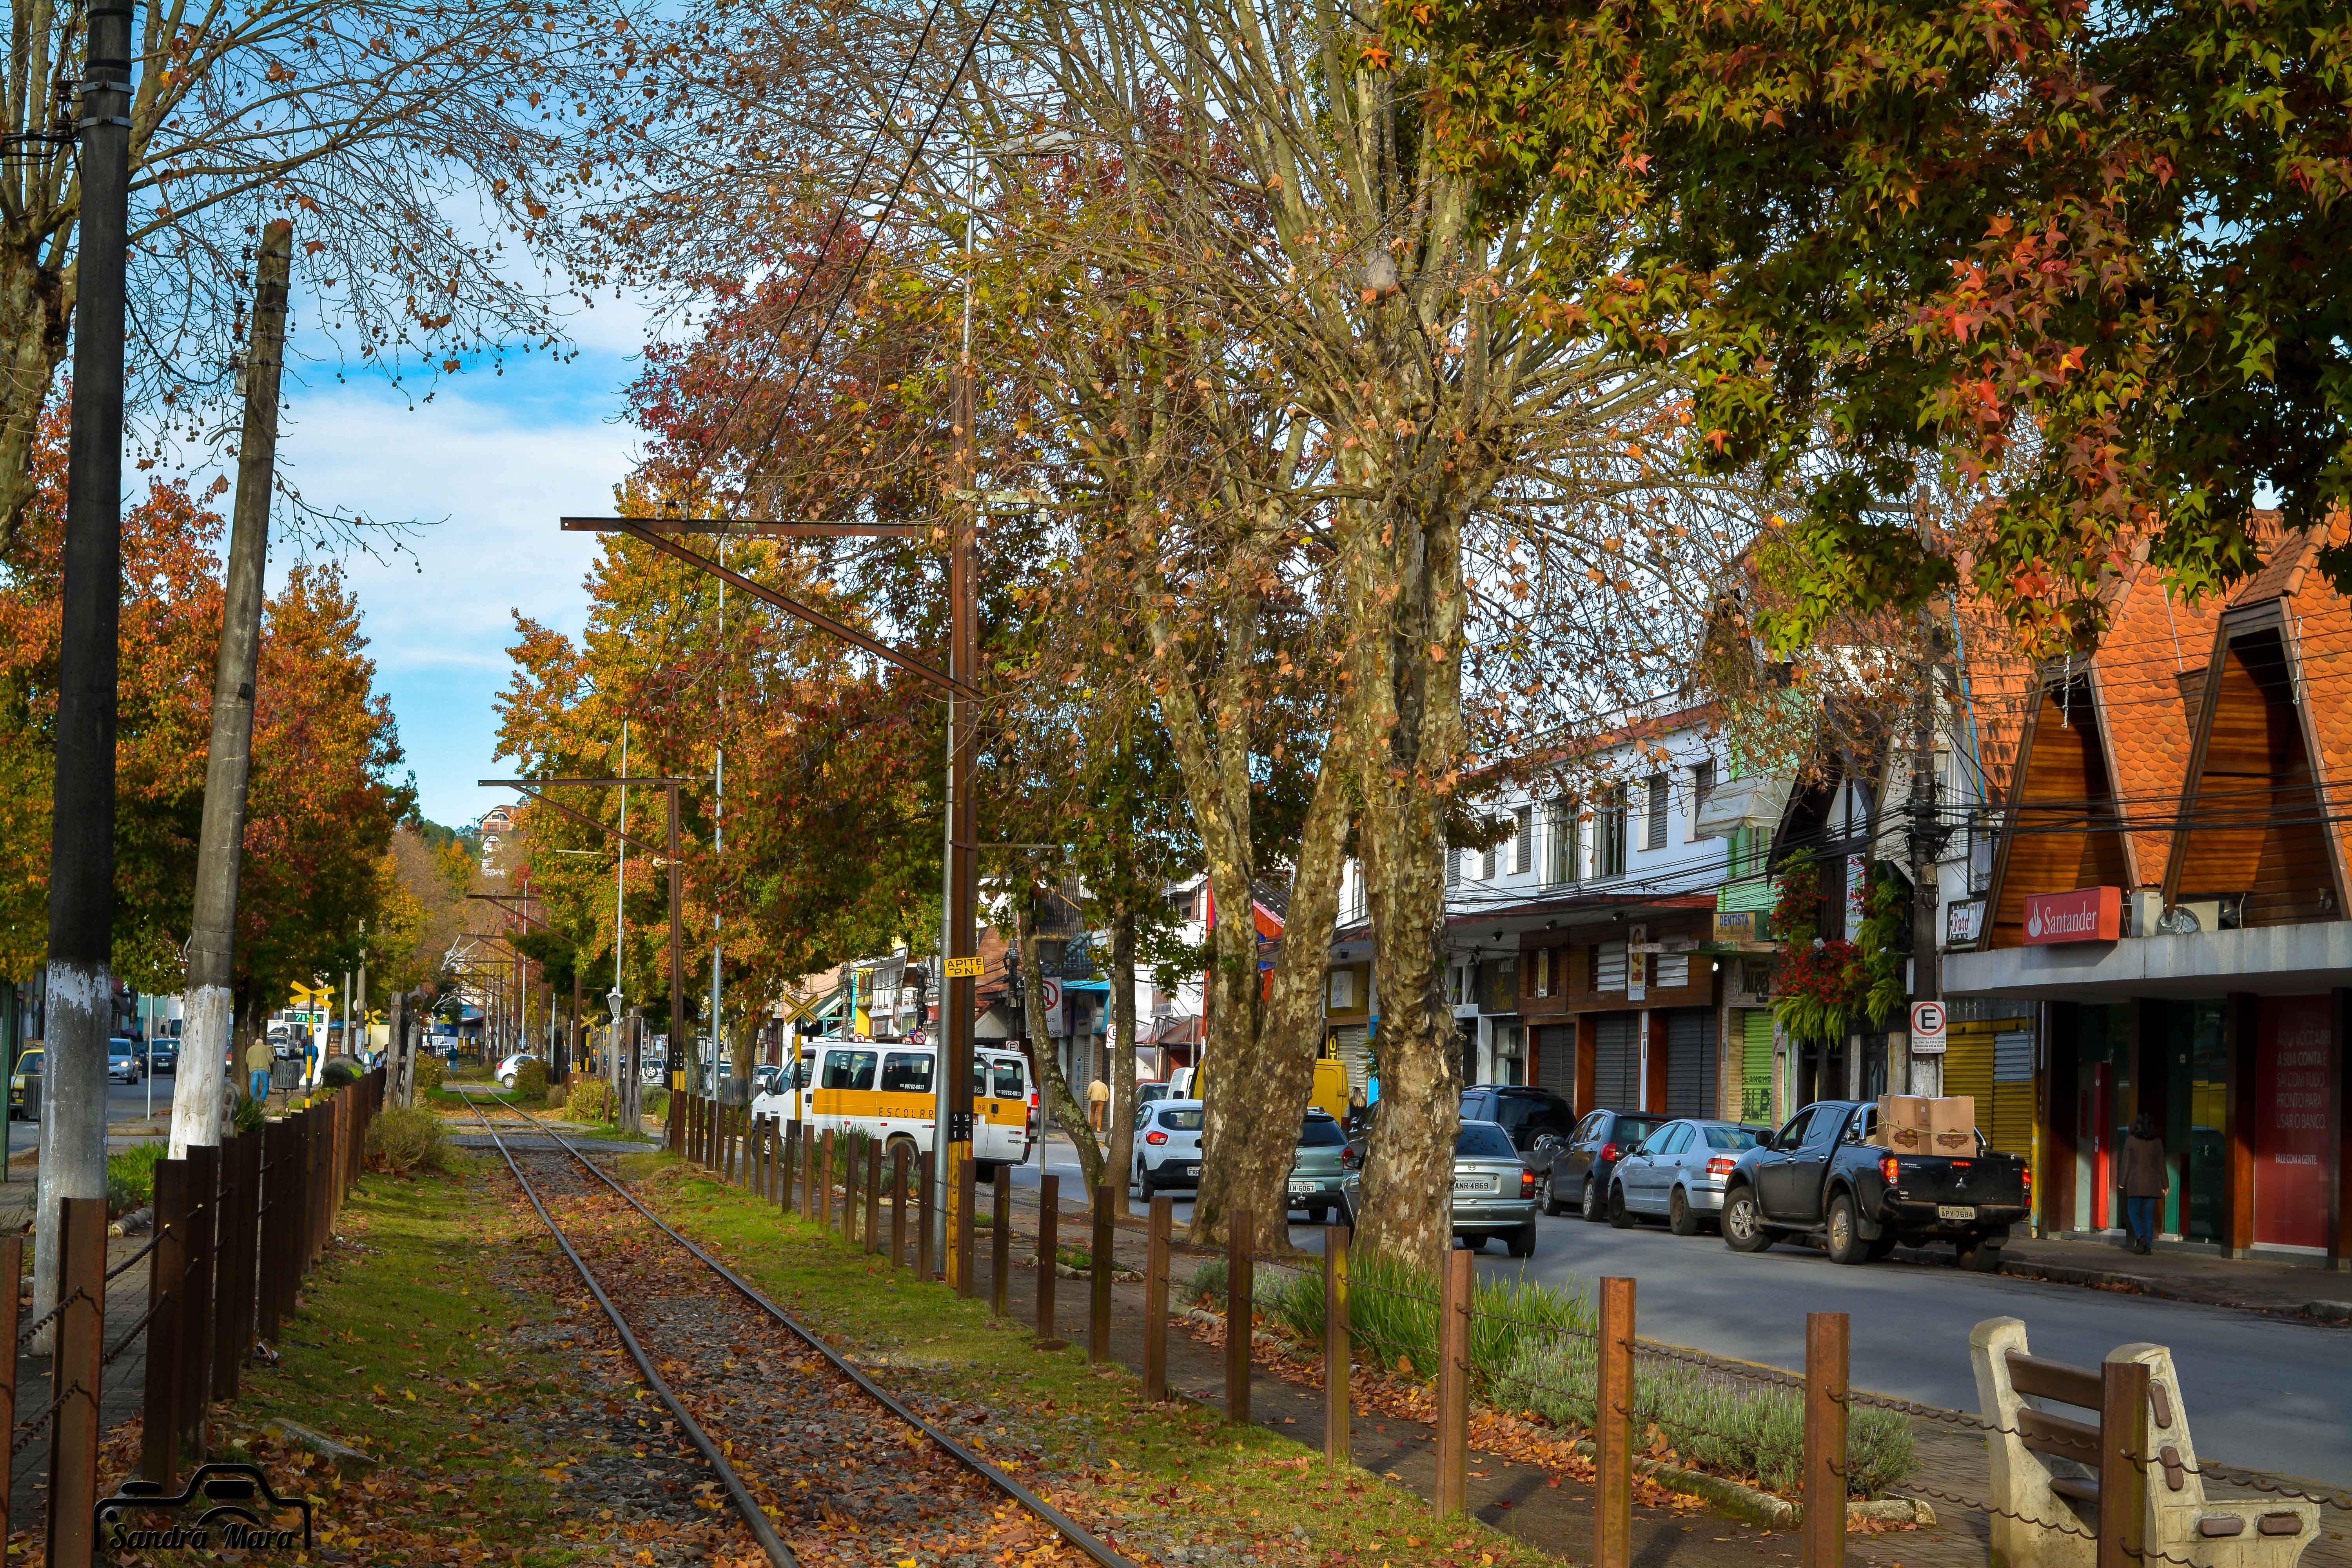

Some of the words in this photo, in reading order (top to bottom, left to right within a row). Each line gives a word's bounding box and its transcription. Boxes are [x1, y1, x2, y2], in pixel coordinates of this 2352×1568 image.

[1720, 914, 1749, 926] DENTISTA
[1953, 913, 1968, 932] Foto
[2044, 900, 2097, 935] Santander
[948, 958, 982, 968] APITE
[1921, 1009, 1937, 1029] E
[2283, 1051, 2296, 1066] SUA
[2298, 1051, 2321, 1066] CONTA
[2305, 1073, 2325, 1088] TUDO
[2277, 1092, 2304, 1107] PRONTO
[2305, 1093, 2321, 1107] PARA
[878, 1107, 933, 1119] ESCOLAR
[2277, 1113, 2294, 1129] USAR
[2294, 1113, 2300, 1129] O
[2301, 1113, 2327, 1129] BANCO.
[2276, 1154, 2286, 1164] FALE
[2286, 1154, 2297, 1164] COM
[2297, 1154, 2301, 1164] A
